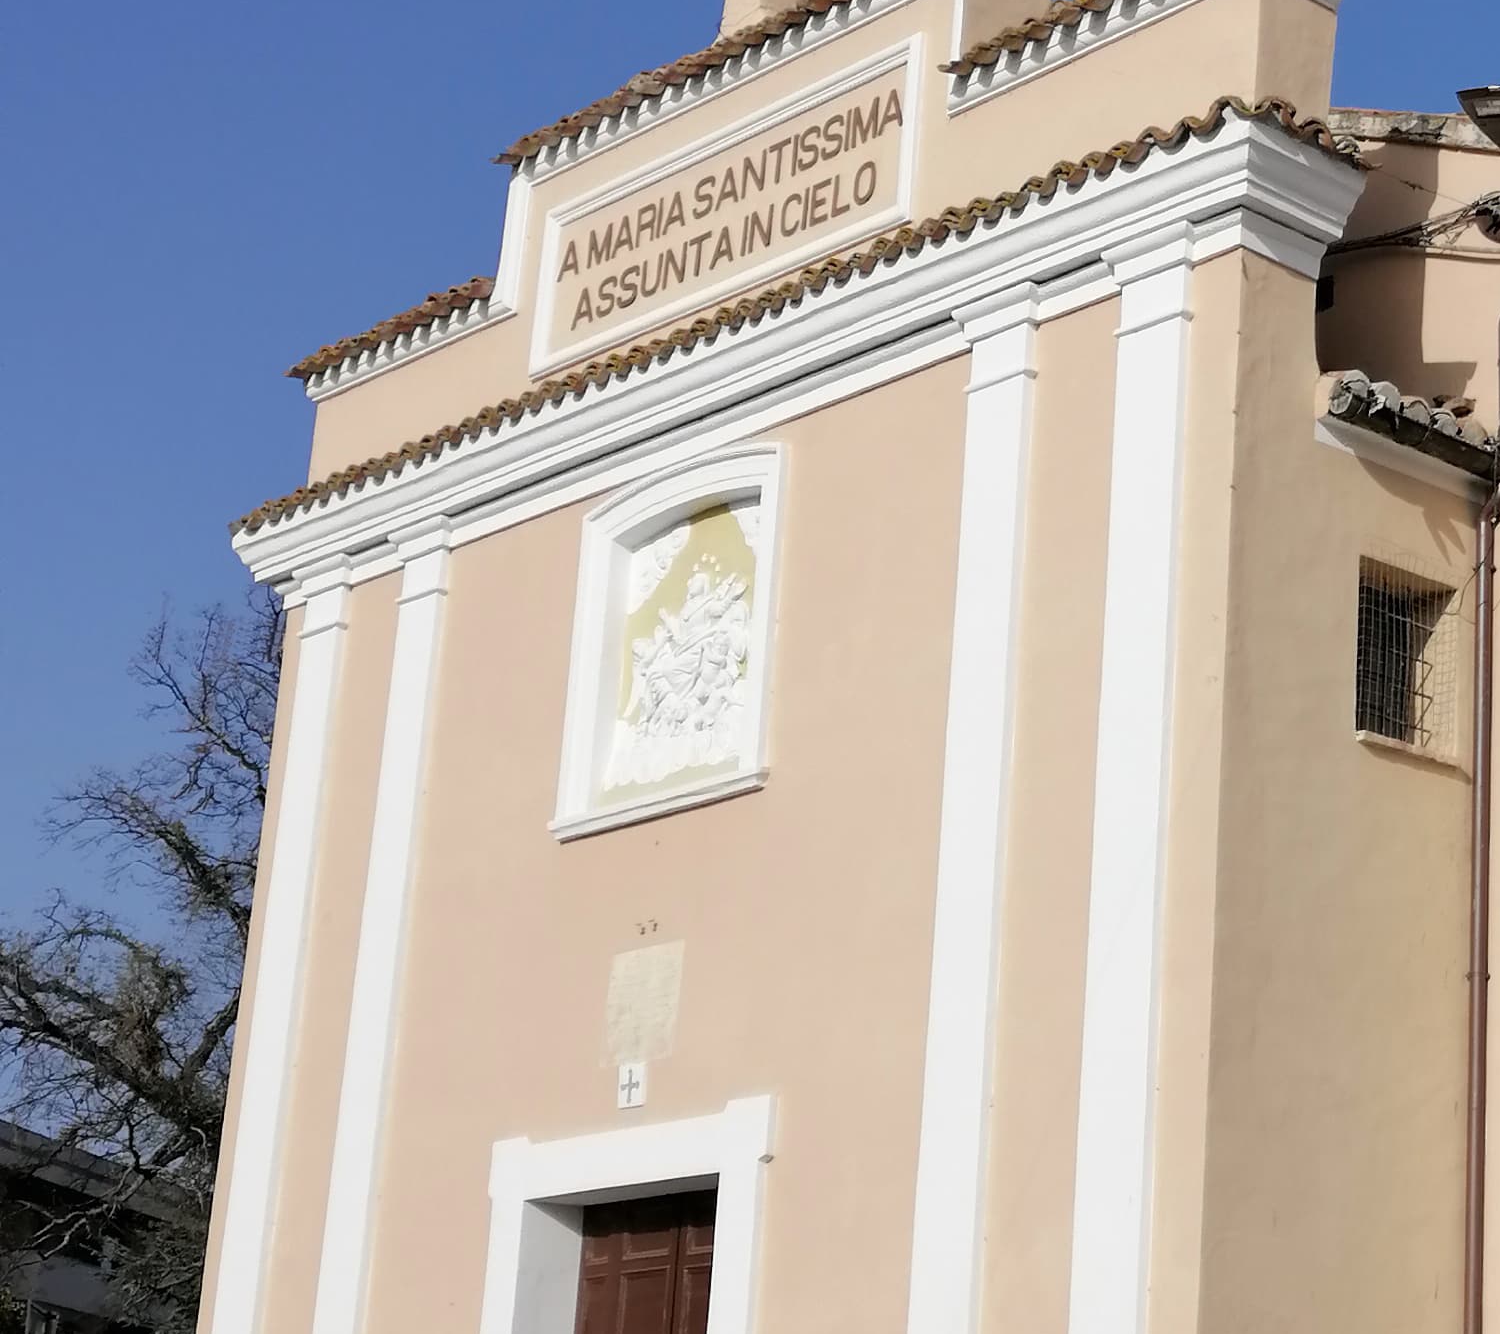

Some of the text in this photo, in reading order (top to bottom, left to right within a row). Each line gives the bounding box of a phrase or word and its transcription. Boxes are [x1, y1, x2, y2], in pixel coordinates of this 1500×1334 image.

[557, 89, 903, 283] A MARIA SANTISSIMA
[572, 160, 877, 330] ASSUNTA IN CIELO
